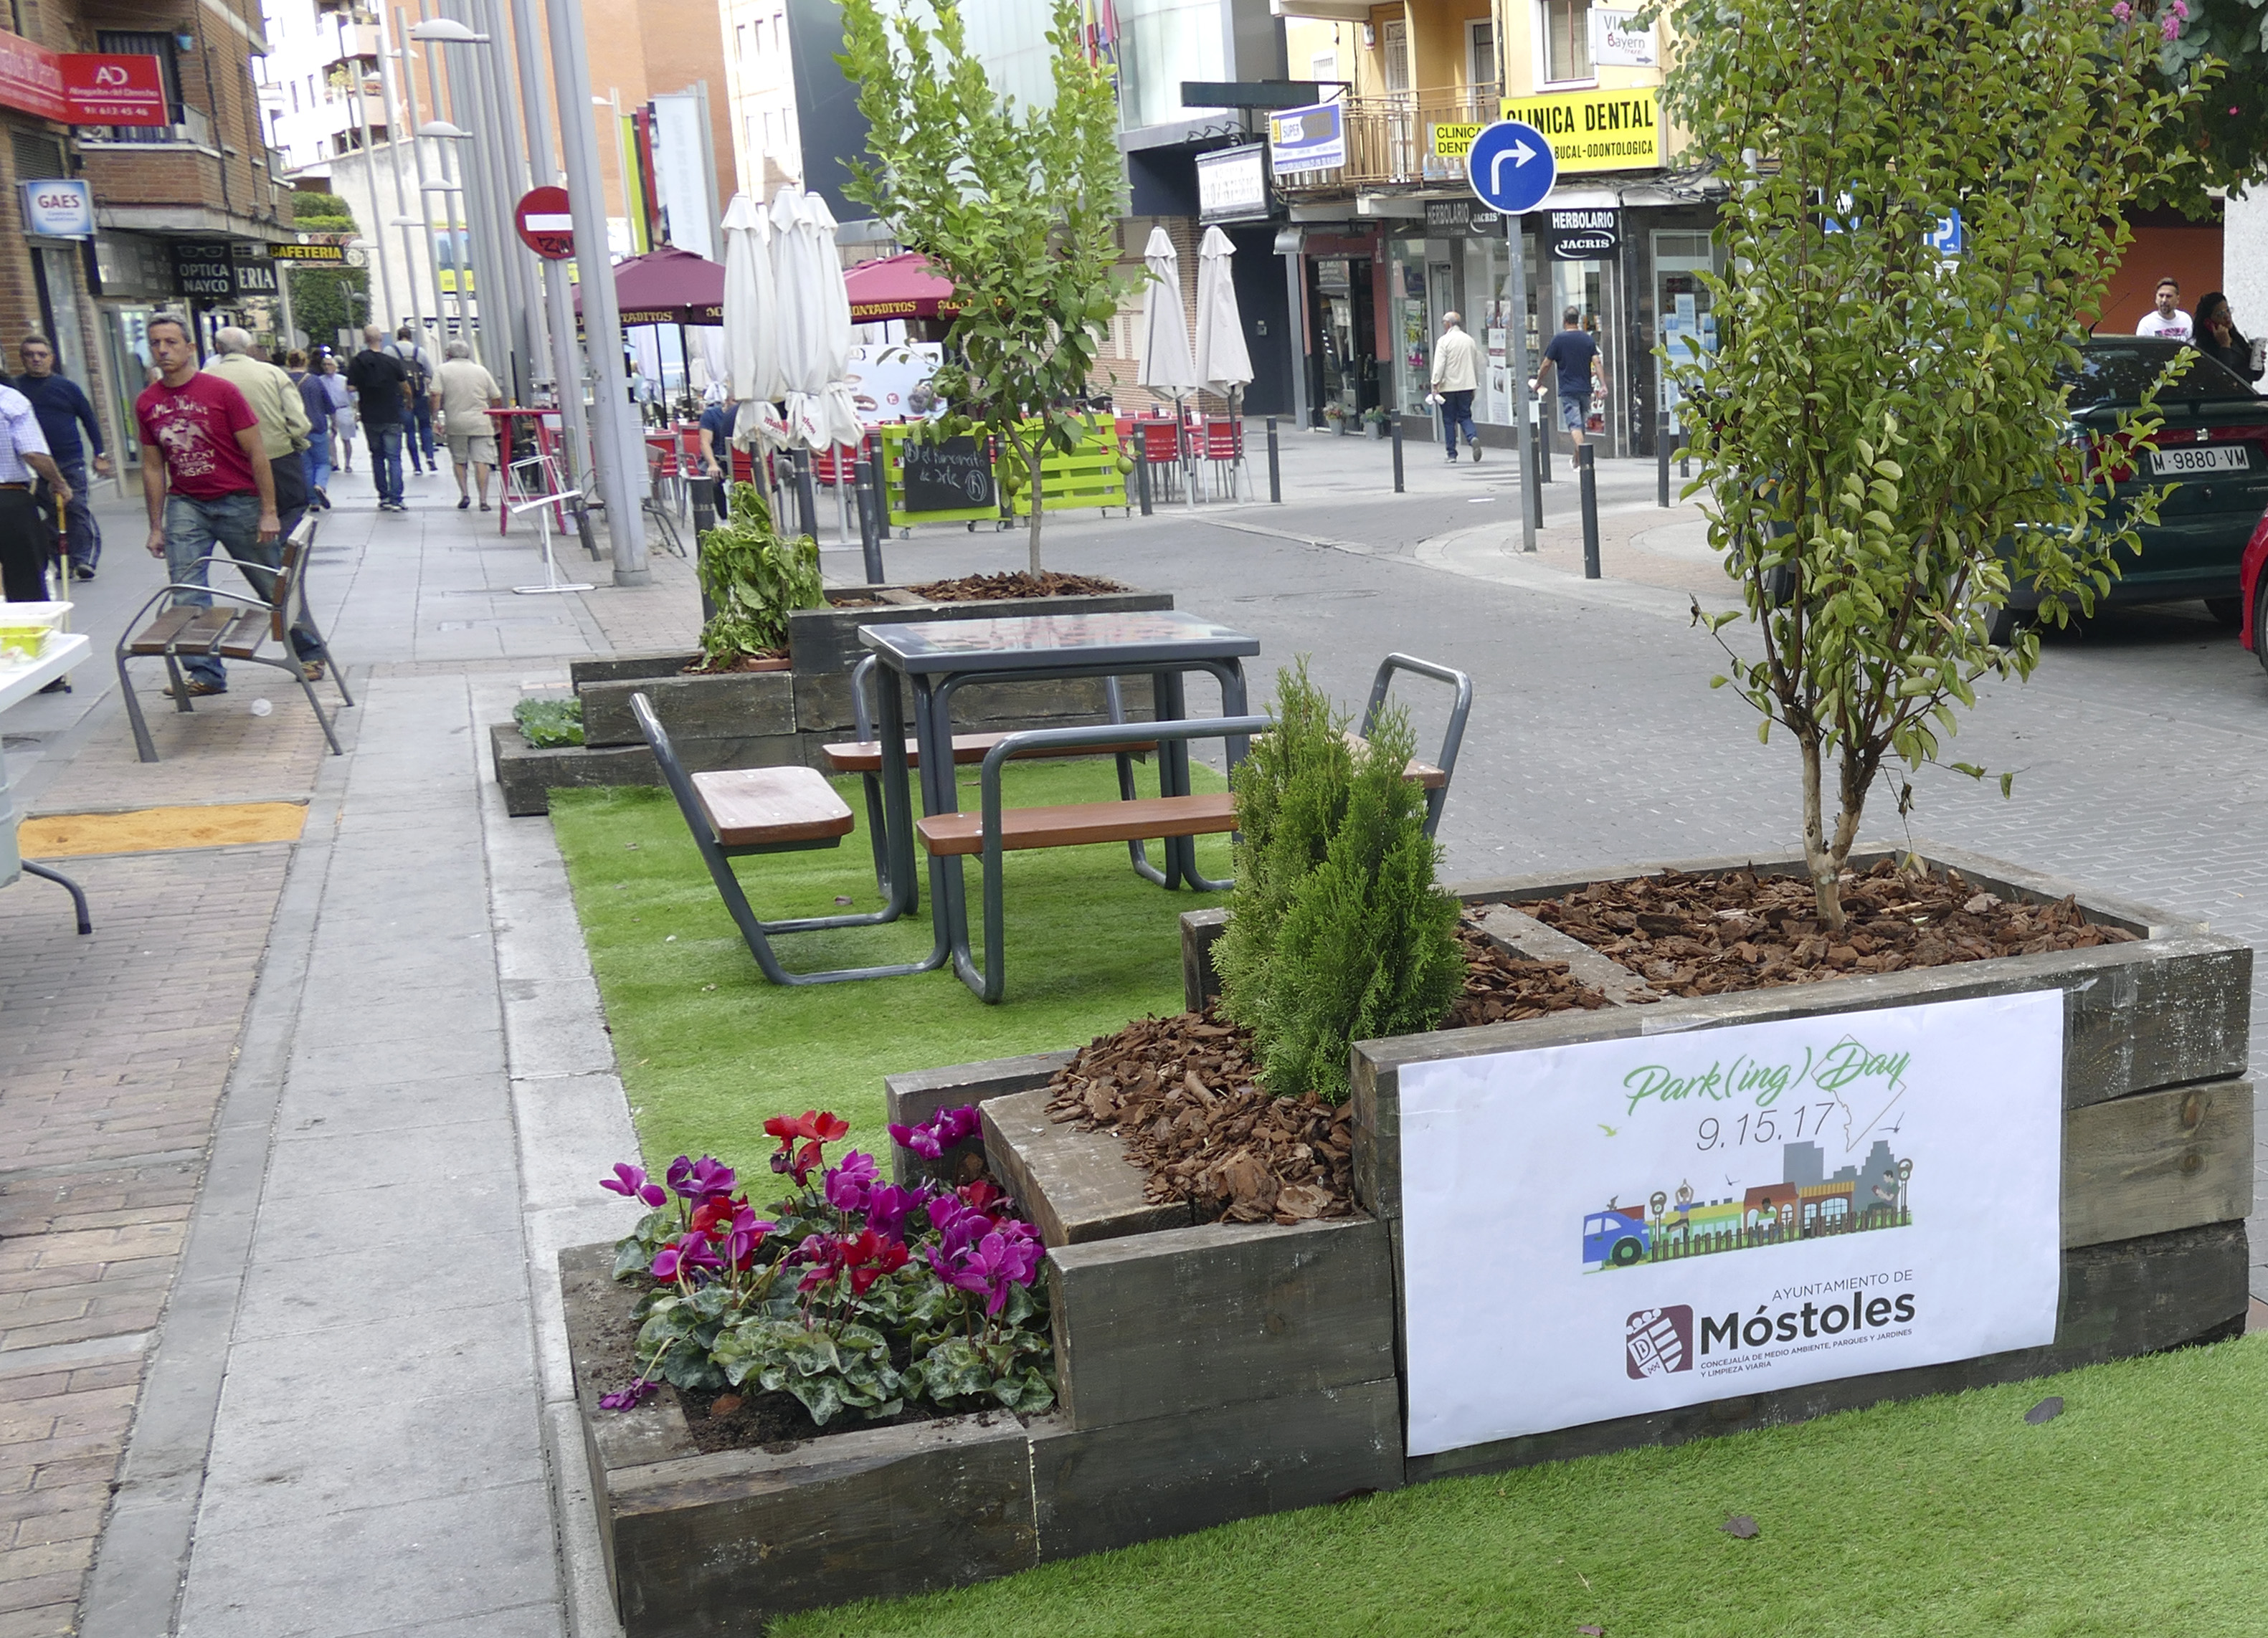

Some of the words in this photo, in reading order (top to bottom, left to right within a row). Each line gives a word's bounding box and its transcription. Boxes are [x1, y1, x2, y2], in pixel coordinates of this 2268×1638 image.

[1607, 32, 1645, 49] Bayern
[1585, 100, 1653, 131] DENTAL
[1438, 142, 1470, 154] DENT
[38, 194, 80, 209] GAES
[1427, 202, 1469, 225] HERBOLARIO
[1552, 211, 1614, 229] HERBOLARIO
[270, 245, 343, 259] CAFETERIA
[1560, 239, 1610, 249] JACRIS
[180, 263, 229, 277] OPTICA
[184, 279, 229, 293] NAYCO
[850, 301, 916, 316] ONTADITOS
[620, 311, 673, 323] TADITOS
[1816, 1042, 1912, 1092] Day
[1697, 1102, 1836, 1151] 9.15.17
[1772, 1275, 1889, 1302] AYUNTAMIENTO
[1894, 1269, 1914, 1282] DE
[1701, 1290, 1916, 1356] Móstoles
[1701, 1354, 1751, 1369] CONCEJALÍA
[1752, 1352, 1763, 1361] DE
[1765, 1348, 1790, 1359] MEDIO
[1791, 1342, 1831, 1355] AMBIENTE,
[1833, 1335, 1869, 1348] PARQUES
[1876, 1328, 1913, 1341] JARDINES
[1708, 1366, 1744, 1377] LIMPIEZA
[1745, 1361, 1772, 1371] VIARIA
